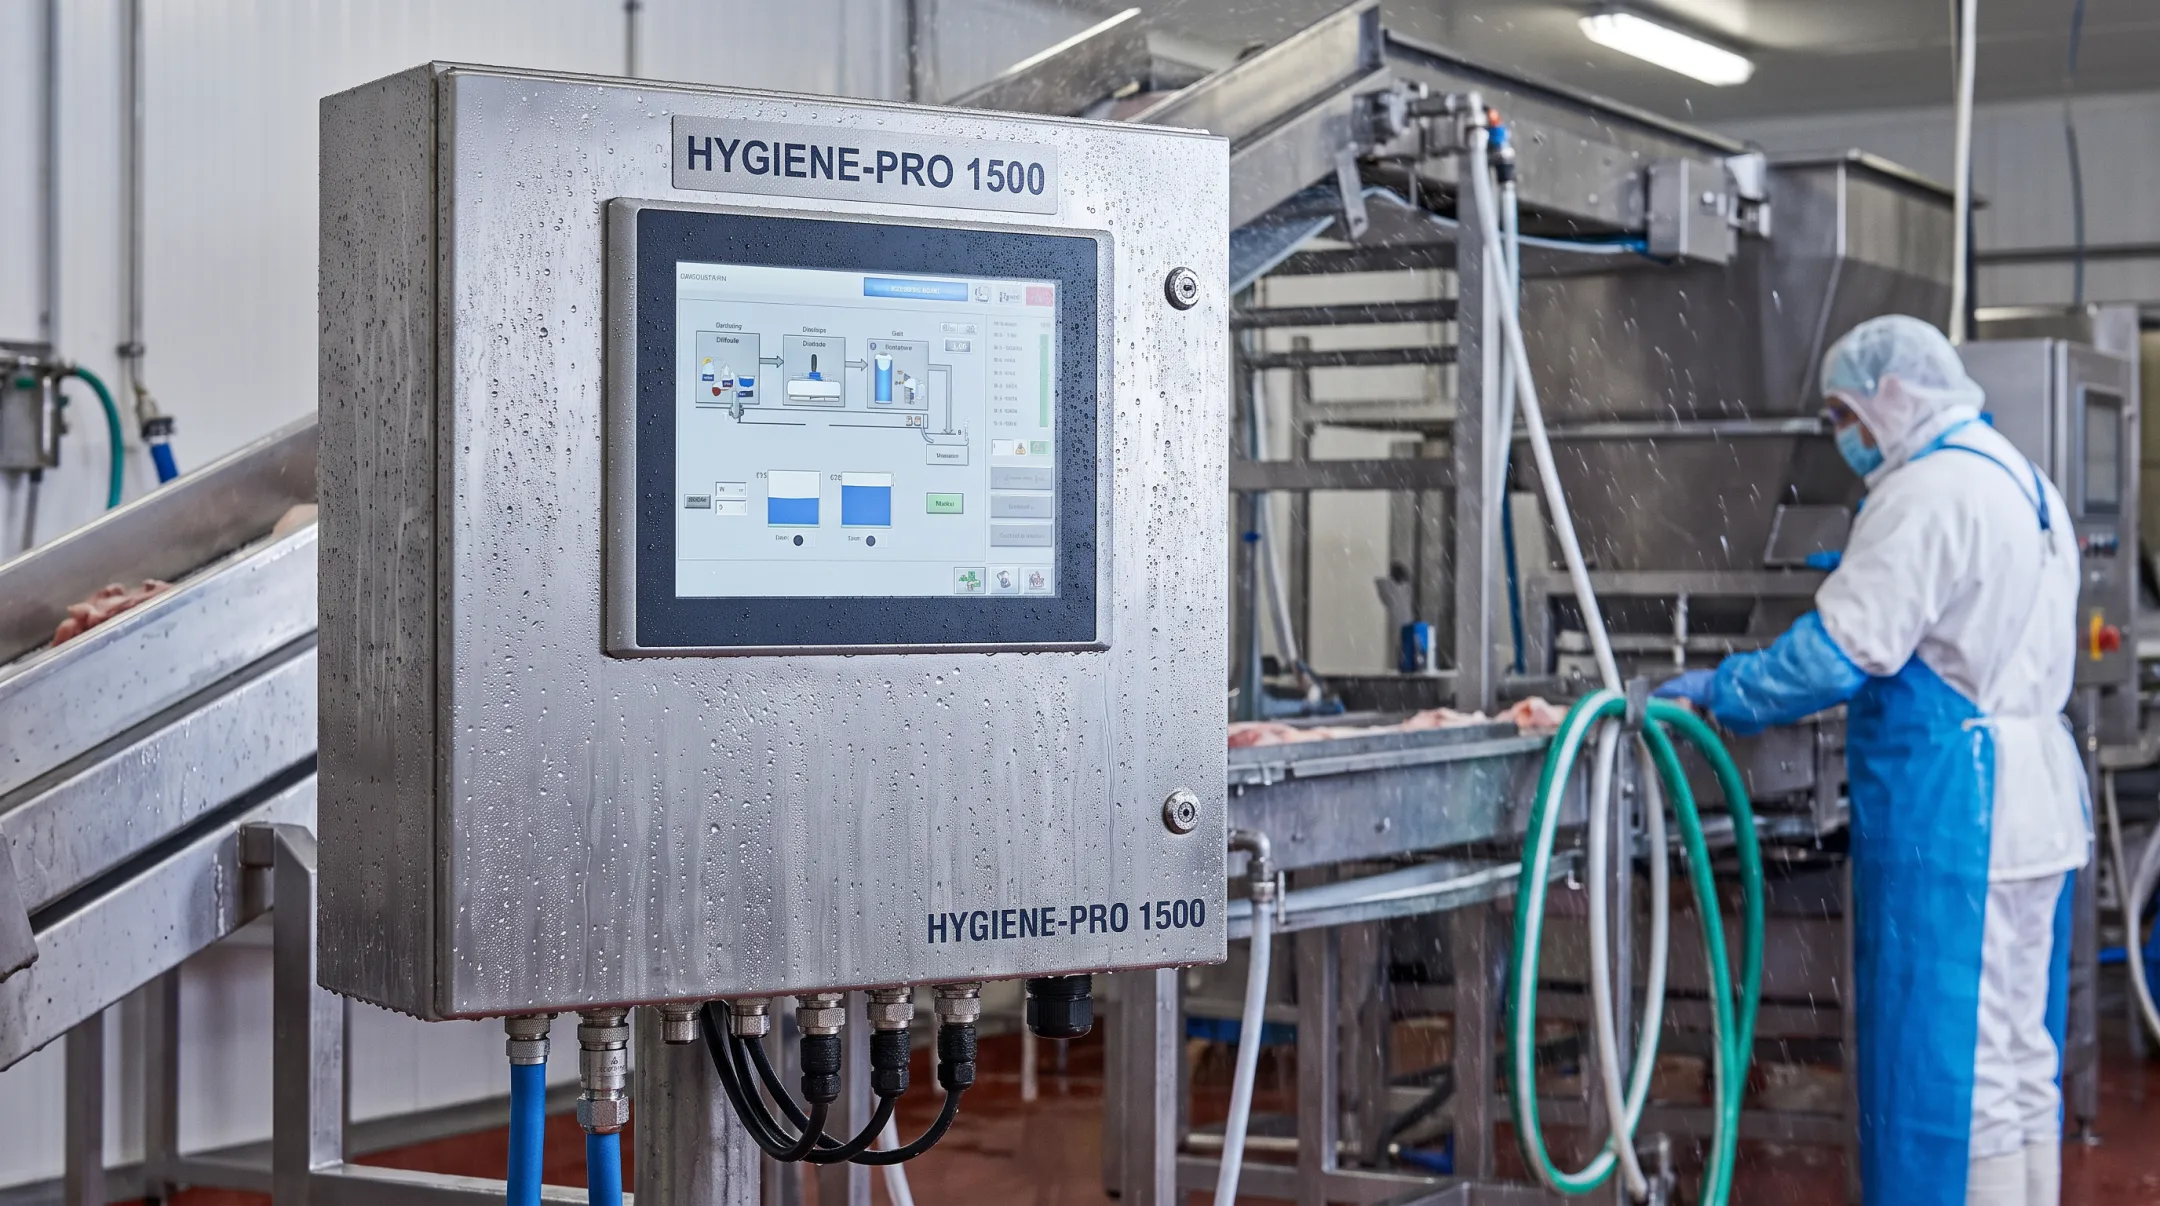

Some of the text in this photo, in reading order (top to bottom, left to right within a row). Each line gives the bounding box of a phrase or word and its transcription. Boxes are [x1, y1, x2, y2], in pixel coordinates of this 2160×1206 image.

[687, 135, 1045, 196] HYGIENE-PRO 1500
[927, 898, 1206, 944] HYGIENE-PRO 1500
